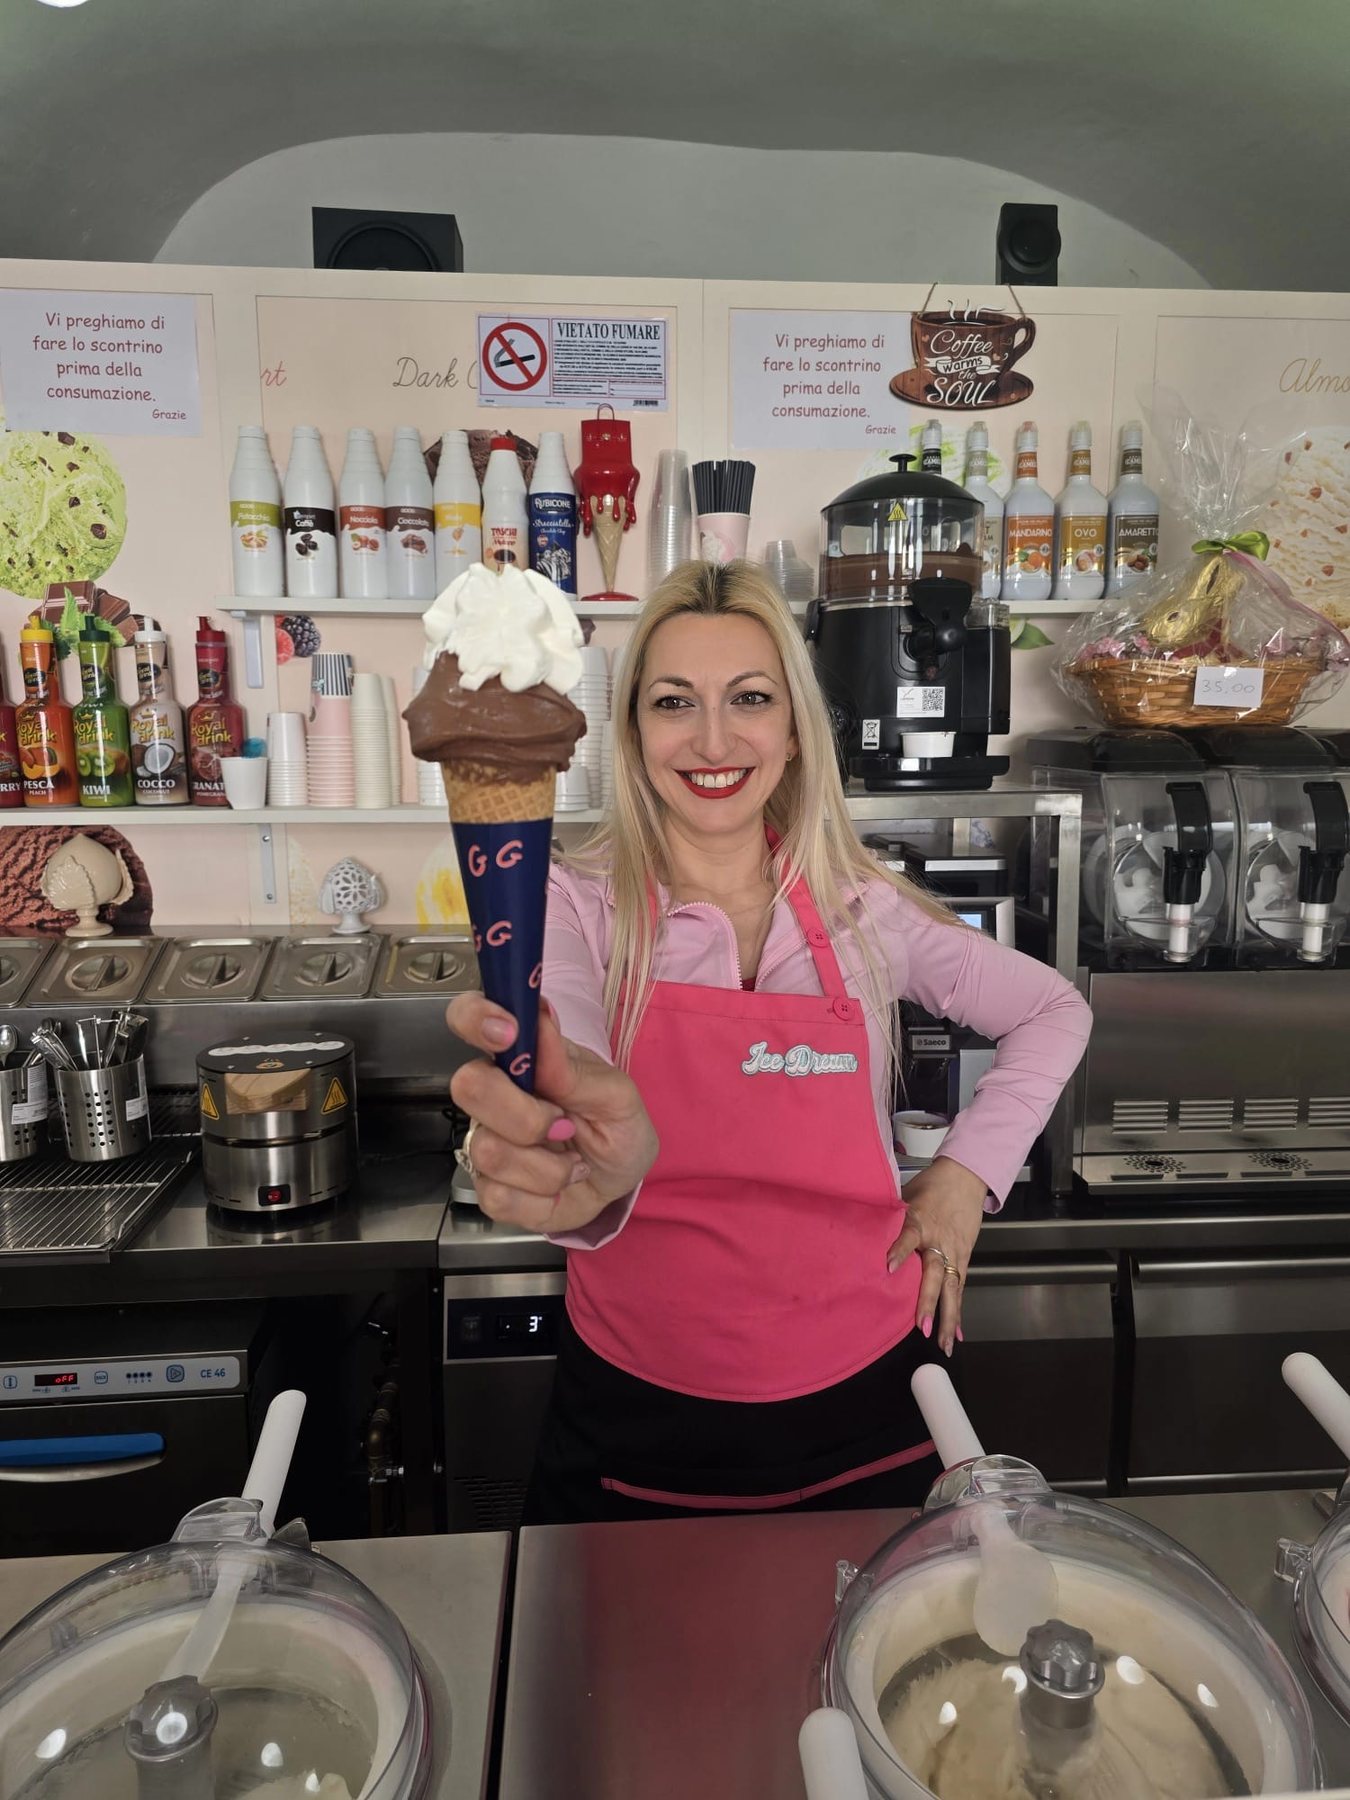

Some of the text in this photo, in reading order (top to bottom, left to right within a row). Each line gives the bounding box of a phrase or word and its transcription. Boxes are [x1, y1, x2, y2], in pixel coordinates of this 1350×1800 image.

[46, 312, 165, 331] Vi preghiamo di
[558, 322, 660, 340] VIETATO FUMARE
[33, 336, 163, 354] fare lo scontrino
[776, 334, 885, 352] Vi preghiamo di
[930, 329, 994, 360] Coffee
[57, 361, 142, 377] prima della
[393, 356, 459, 388] Dark
[763, 357, 881, 373] fare lo scontrino
[943, 356, 983, 373] warms
[958, 370, 976, 380] the
[47, 385, 156, 402] consumazione.
[783, 381, 860, 397] prima della
[926, 377, 996, 407] SOUL
[152, 409, 187, 420] Grazie
[772, 405, 870, 418] consumazione.
[865, 425, 896, 435] Grazie
[535, 498, 571, 508] RUBICONE
[295, 519, 314, 527] Caffè
[350, 516, 378, 524] Nocciola
[491, 528, 517, 536] TOSCHI
[1009, 528, 1052, 537] MANDARINO
[1074, 528, 1097, 538] OVO
[1202, 679, 1255, 695] 35.00
[190, 718, 225, 735] Royal
[197, 731, 232, 746] drink
[24, 781, 54, 789] PESCA
[83, 785, 111, 795] KIWI
[138, 779, 175, 788] COCCO
[468, 840, 524, 877] G G
[486, 920, 513, 947] G
[924, 1038, 947, 1047] Saeco
[509, 1053, 532, 1076] G
[742, 1041, 858, 1076] Ice Dream
[200, 1368, 226, 1378] CE 46
